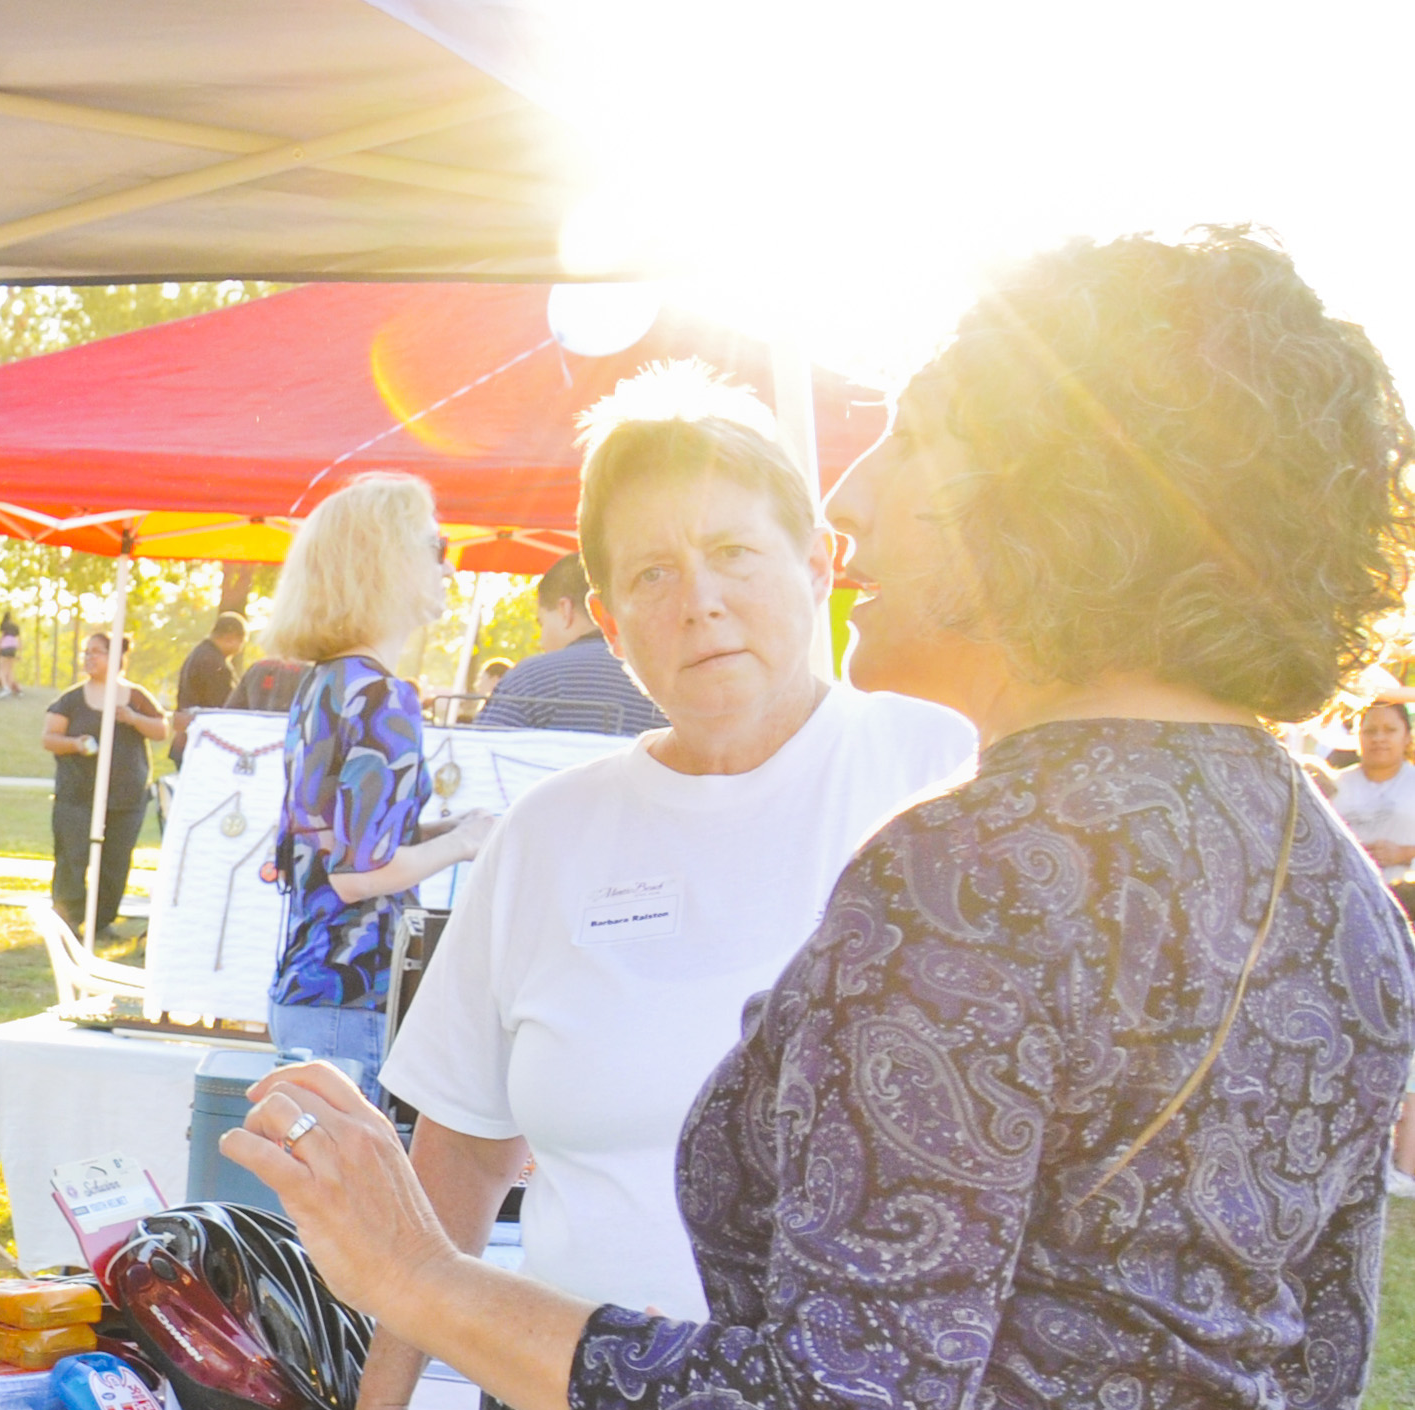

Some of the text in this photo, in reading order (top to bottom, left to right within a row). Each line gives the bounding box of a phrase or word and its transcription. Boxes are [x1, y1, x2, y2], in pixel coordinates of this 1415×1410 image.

[591, 911, 669, 928] Barbara Ralston
[149, 1304, 204, 1363] SCHWINN
